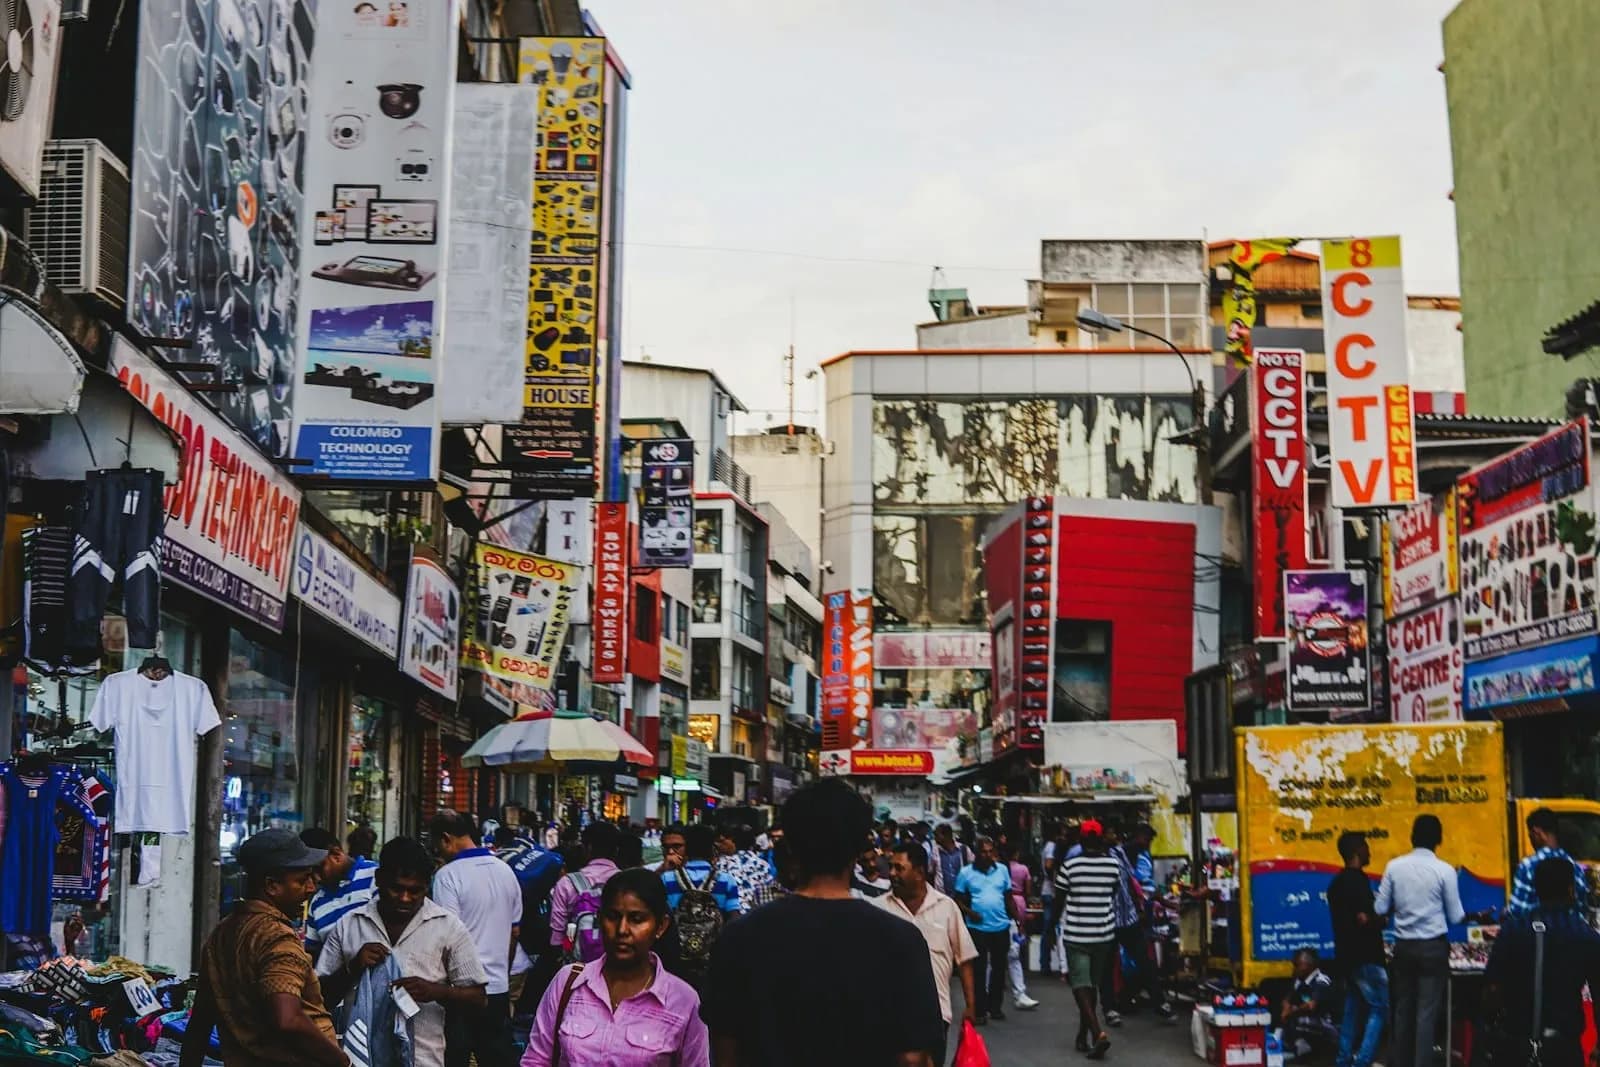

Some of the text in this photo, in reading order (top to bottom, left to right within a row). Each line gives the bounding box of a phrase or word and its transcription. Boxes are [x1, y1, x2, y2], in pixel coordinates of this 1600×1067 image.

[1351, 238, 1372, 268] 8
[1259, 354, 1283, 367] NO
[531, 388, 590, 404] HOUSE
[1331, 271, 1384, 504] CCTV
[318, 442, 412, 455] TECHNOLOGY
[330, 426, 402, 438] COLOMBO
[1264, 368, 1300, 488] CCTV
[1388, 385, 1414, 503] CENTRE
[200, 437, 298, 593] TECHNOLOGY
[601, 531, 620, 592] BOMBAY
[599, 599, 622, 659] SWEETS
[1403, 607, 1444, 654] CCTV
[1401, 655, 1450, 695] CENTRE
